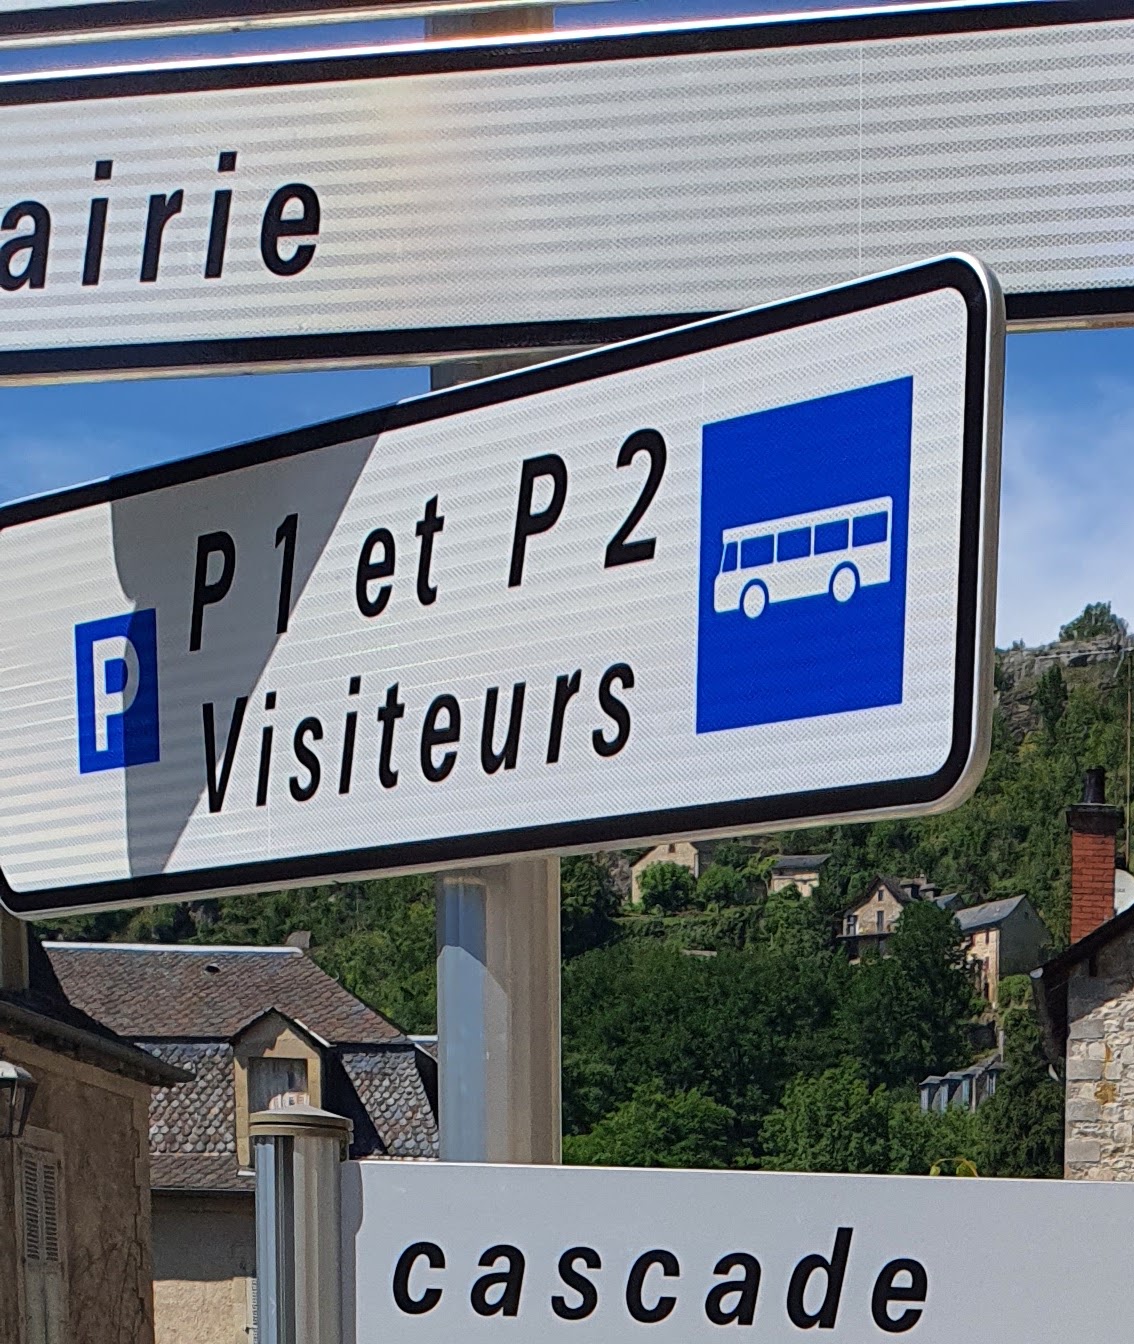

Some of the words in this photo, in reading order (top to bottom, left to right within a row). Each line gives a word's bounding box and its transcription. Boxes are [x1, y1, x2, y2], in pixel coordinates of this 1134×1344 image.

[0, 151, 321, 292] airie
[355, 495, 446, 618] et
[201, 662, 635, 814] Visiteurs
[392, 1226, 929, 1334] cascade
